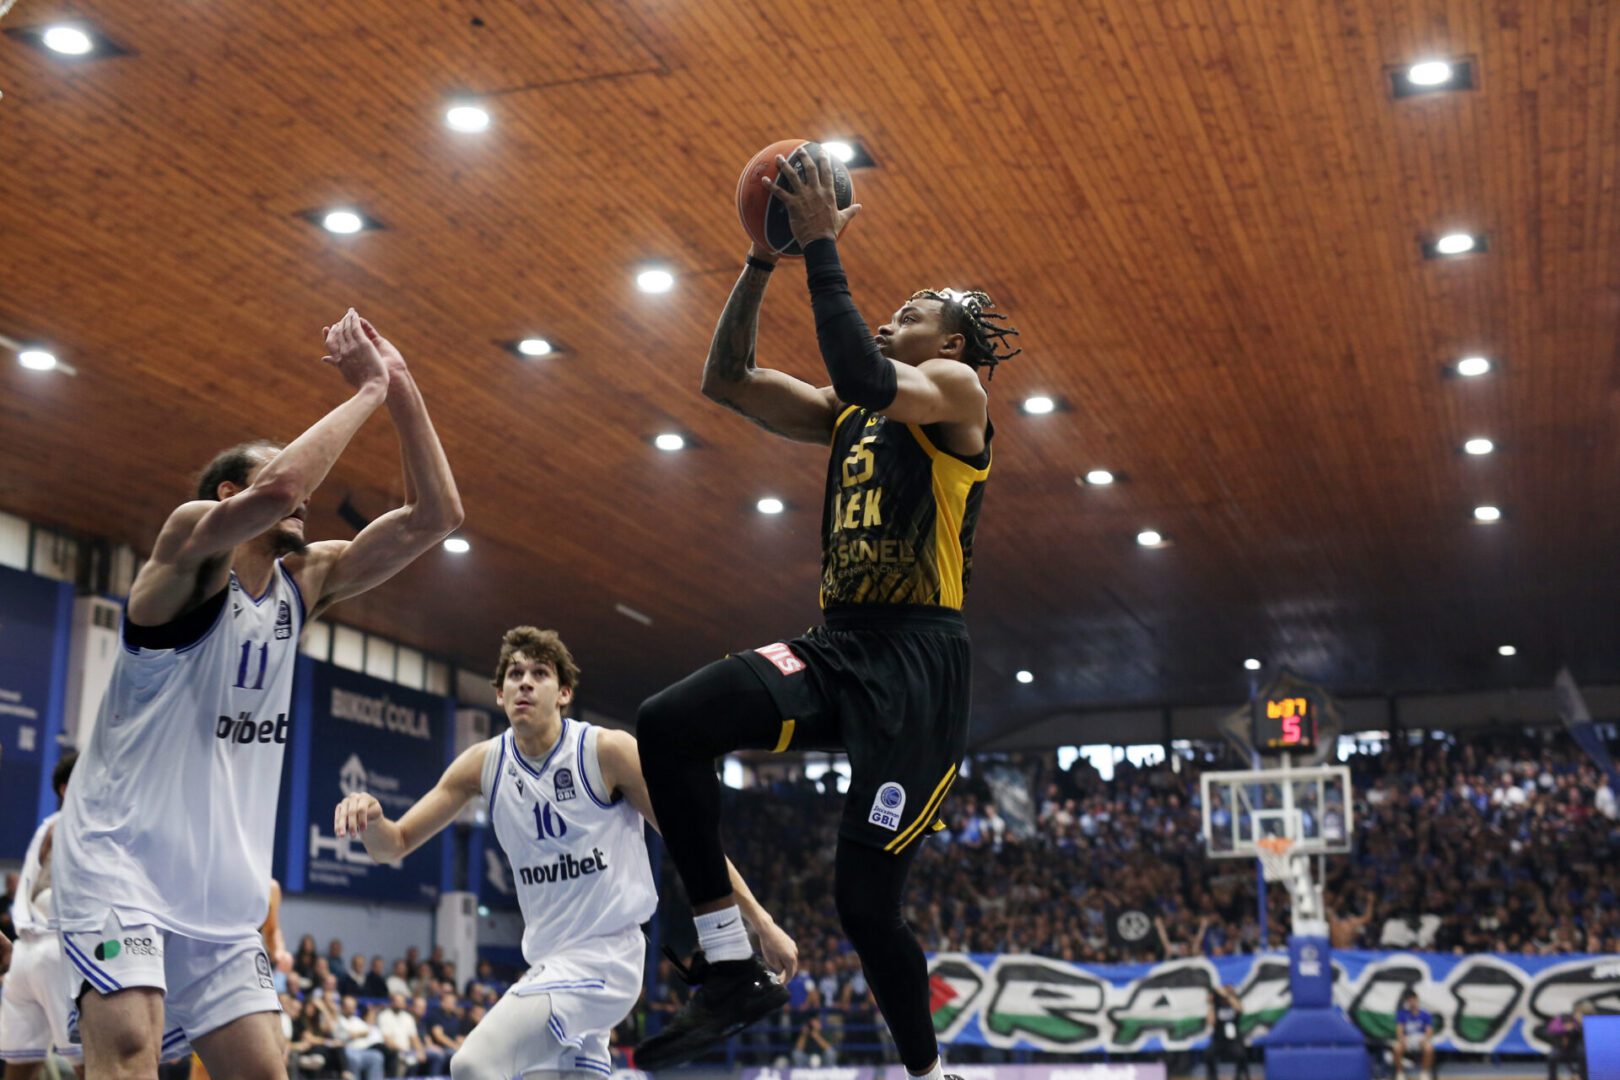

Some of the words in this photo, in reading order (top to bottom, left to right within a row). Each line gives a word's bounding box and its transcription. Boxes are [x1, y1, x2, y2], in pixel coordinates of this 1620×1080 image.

[842, 435, 877, 487] 25
[233, 640, 268, 690] 11
[1282, 714, 1301, 743] 5
[532, 801, 567, 840] 16
[871, 812, 896, 828] GBL
[519, 847, 608, 885] novibet
[123, 937, 152, 947] eco
